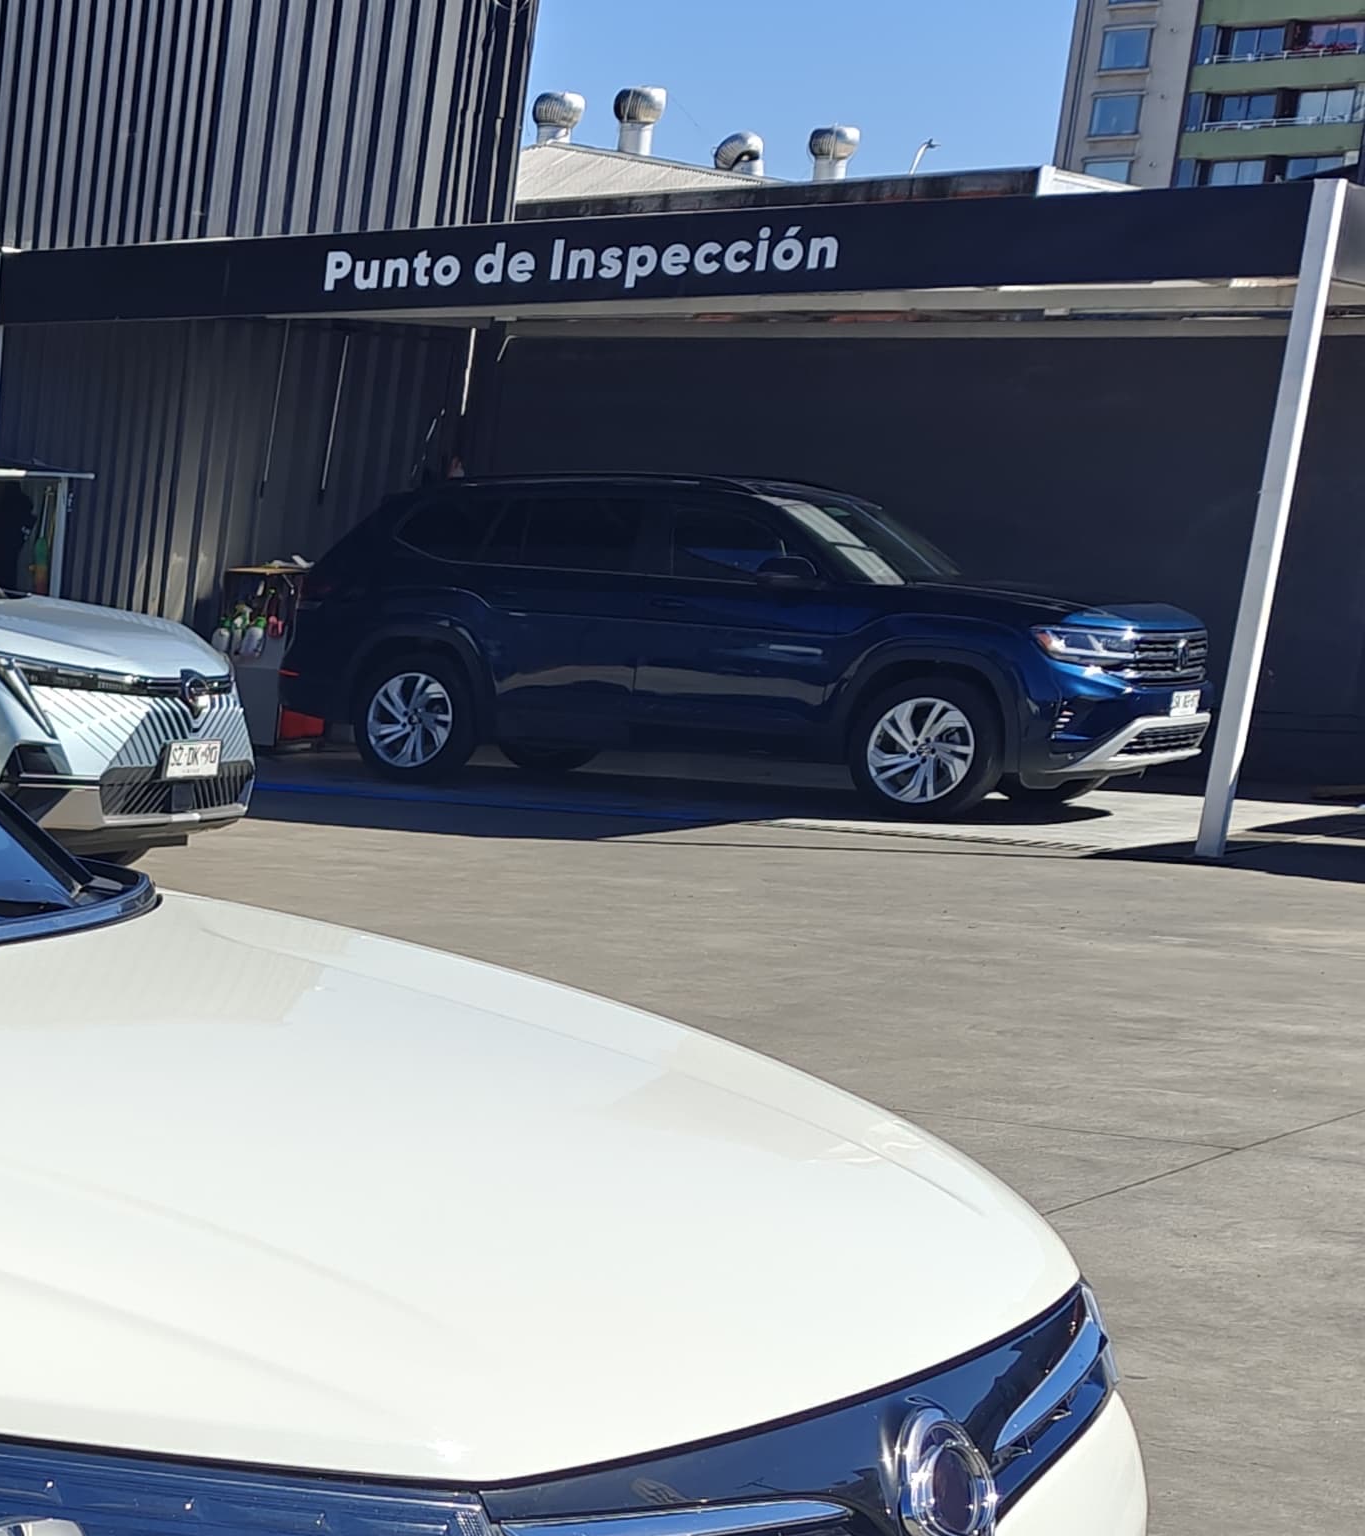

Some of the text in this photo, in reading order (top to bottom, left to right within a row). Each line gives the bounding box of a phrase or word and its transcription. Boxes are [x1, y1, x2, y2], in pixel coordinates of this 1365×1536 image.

[322, 225, 840, 292] Punto de Inspección
